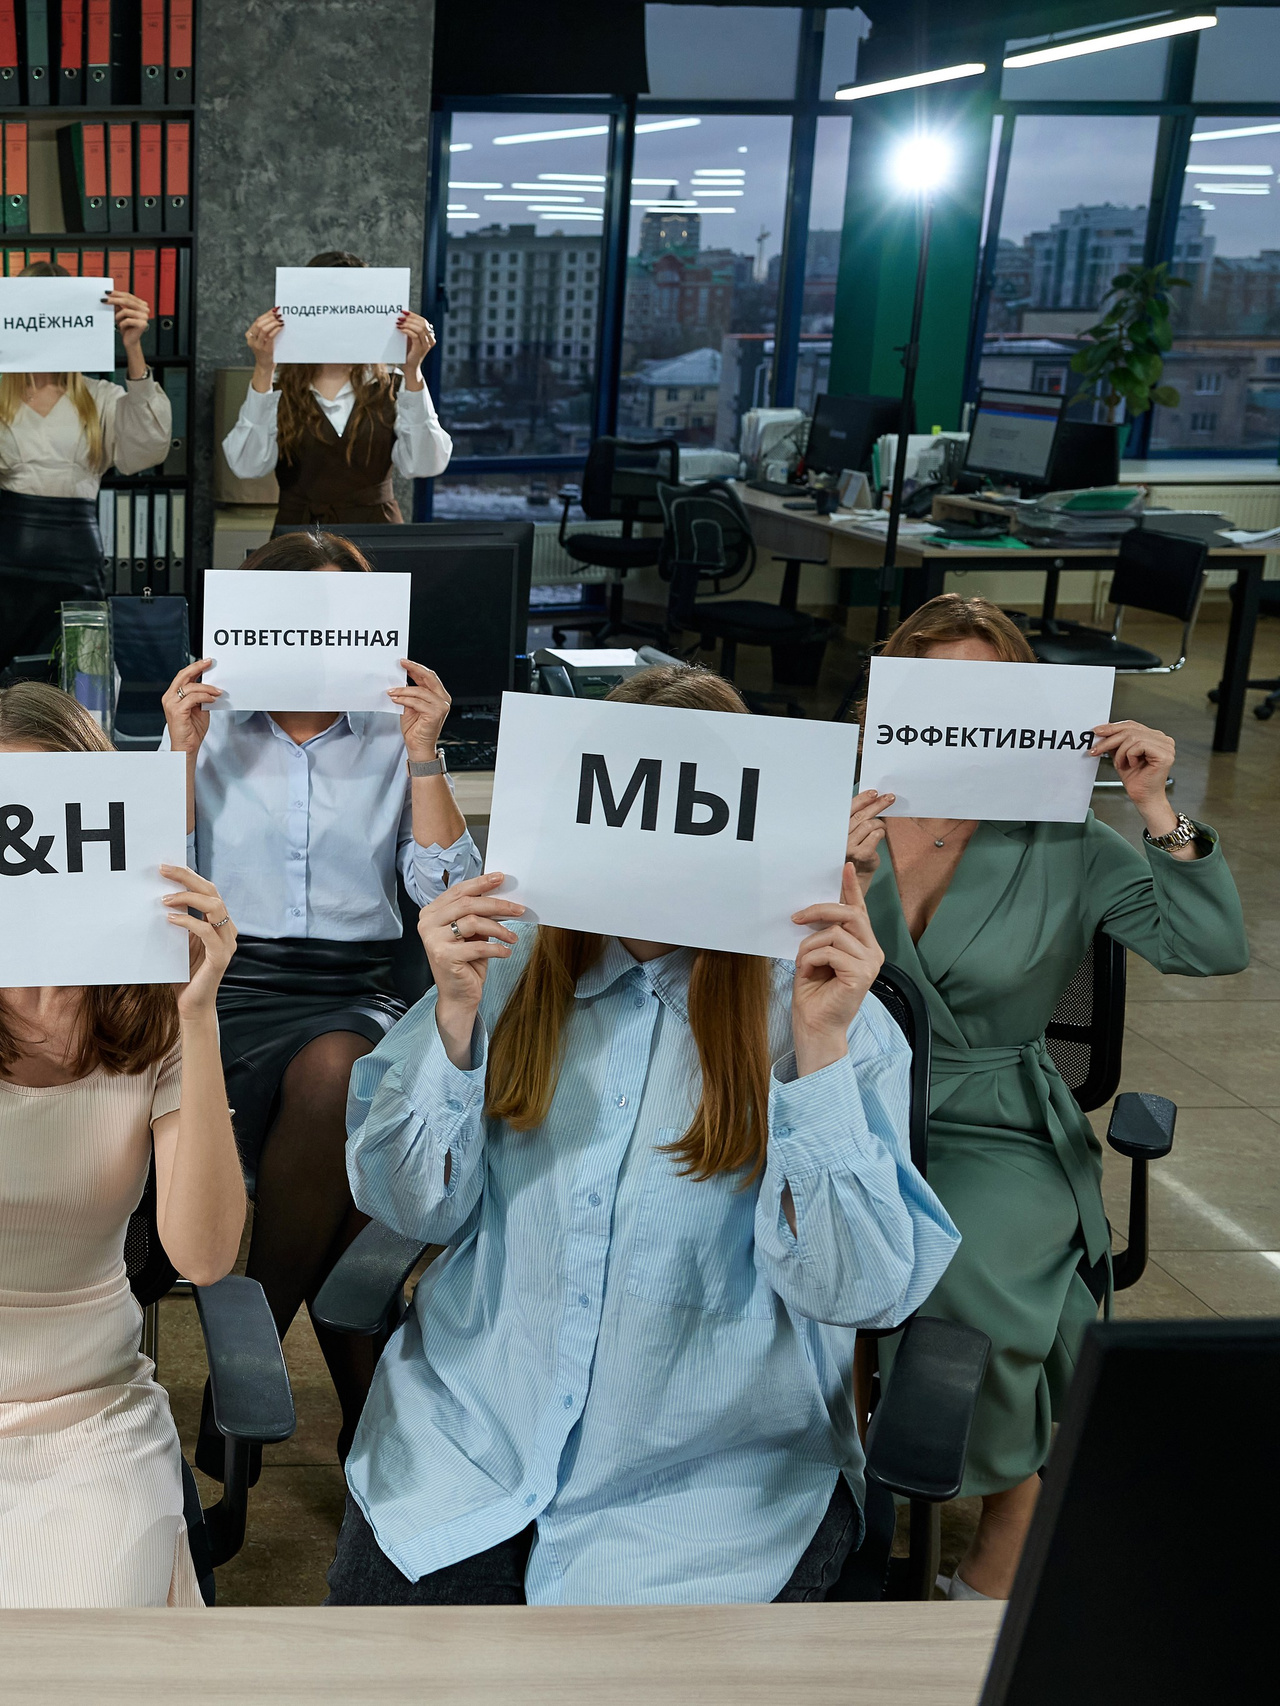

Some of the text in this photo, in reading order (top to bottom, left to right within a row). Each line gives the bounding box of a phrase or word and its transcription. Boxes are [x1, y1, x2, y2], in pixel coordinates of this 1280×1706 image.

[282, 304, 403, 317] ПОДДЕРЖИВАЮЩАЯ
[3, 313, 94, 333] НАДЁЖНАЯ
[213, 628, 400, 648] ОТВЕТСТВЕННАЯ
[876, 724, 1095, 750] ЭФФЕКТИВНАЯ
[575, 752, 761, 842] МЫ
